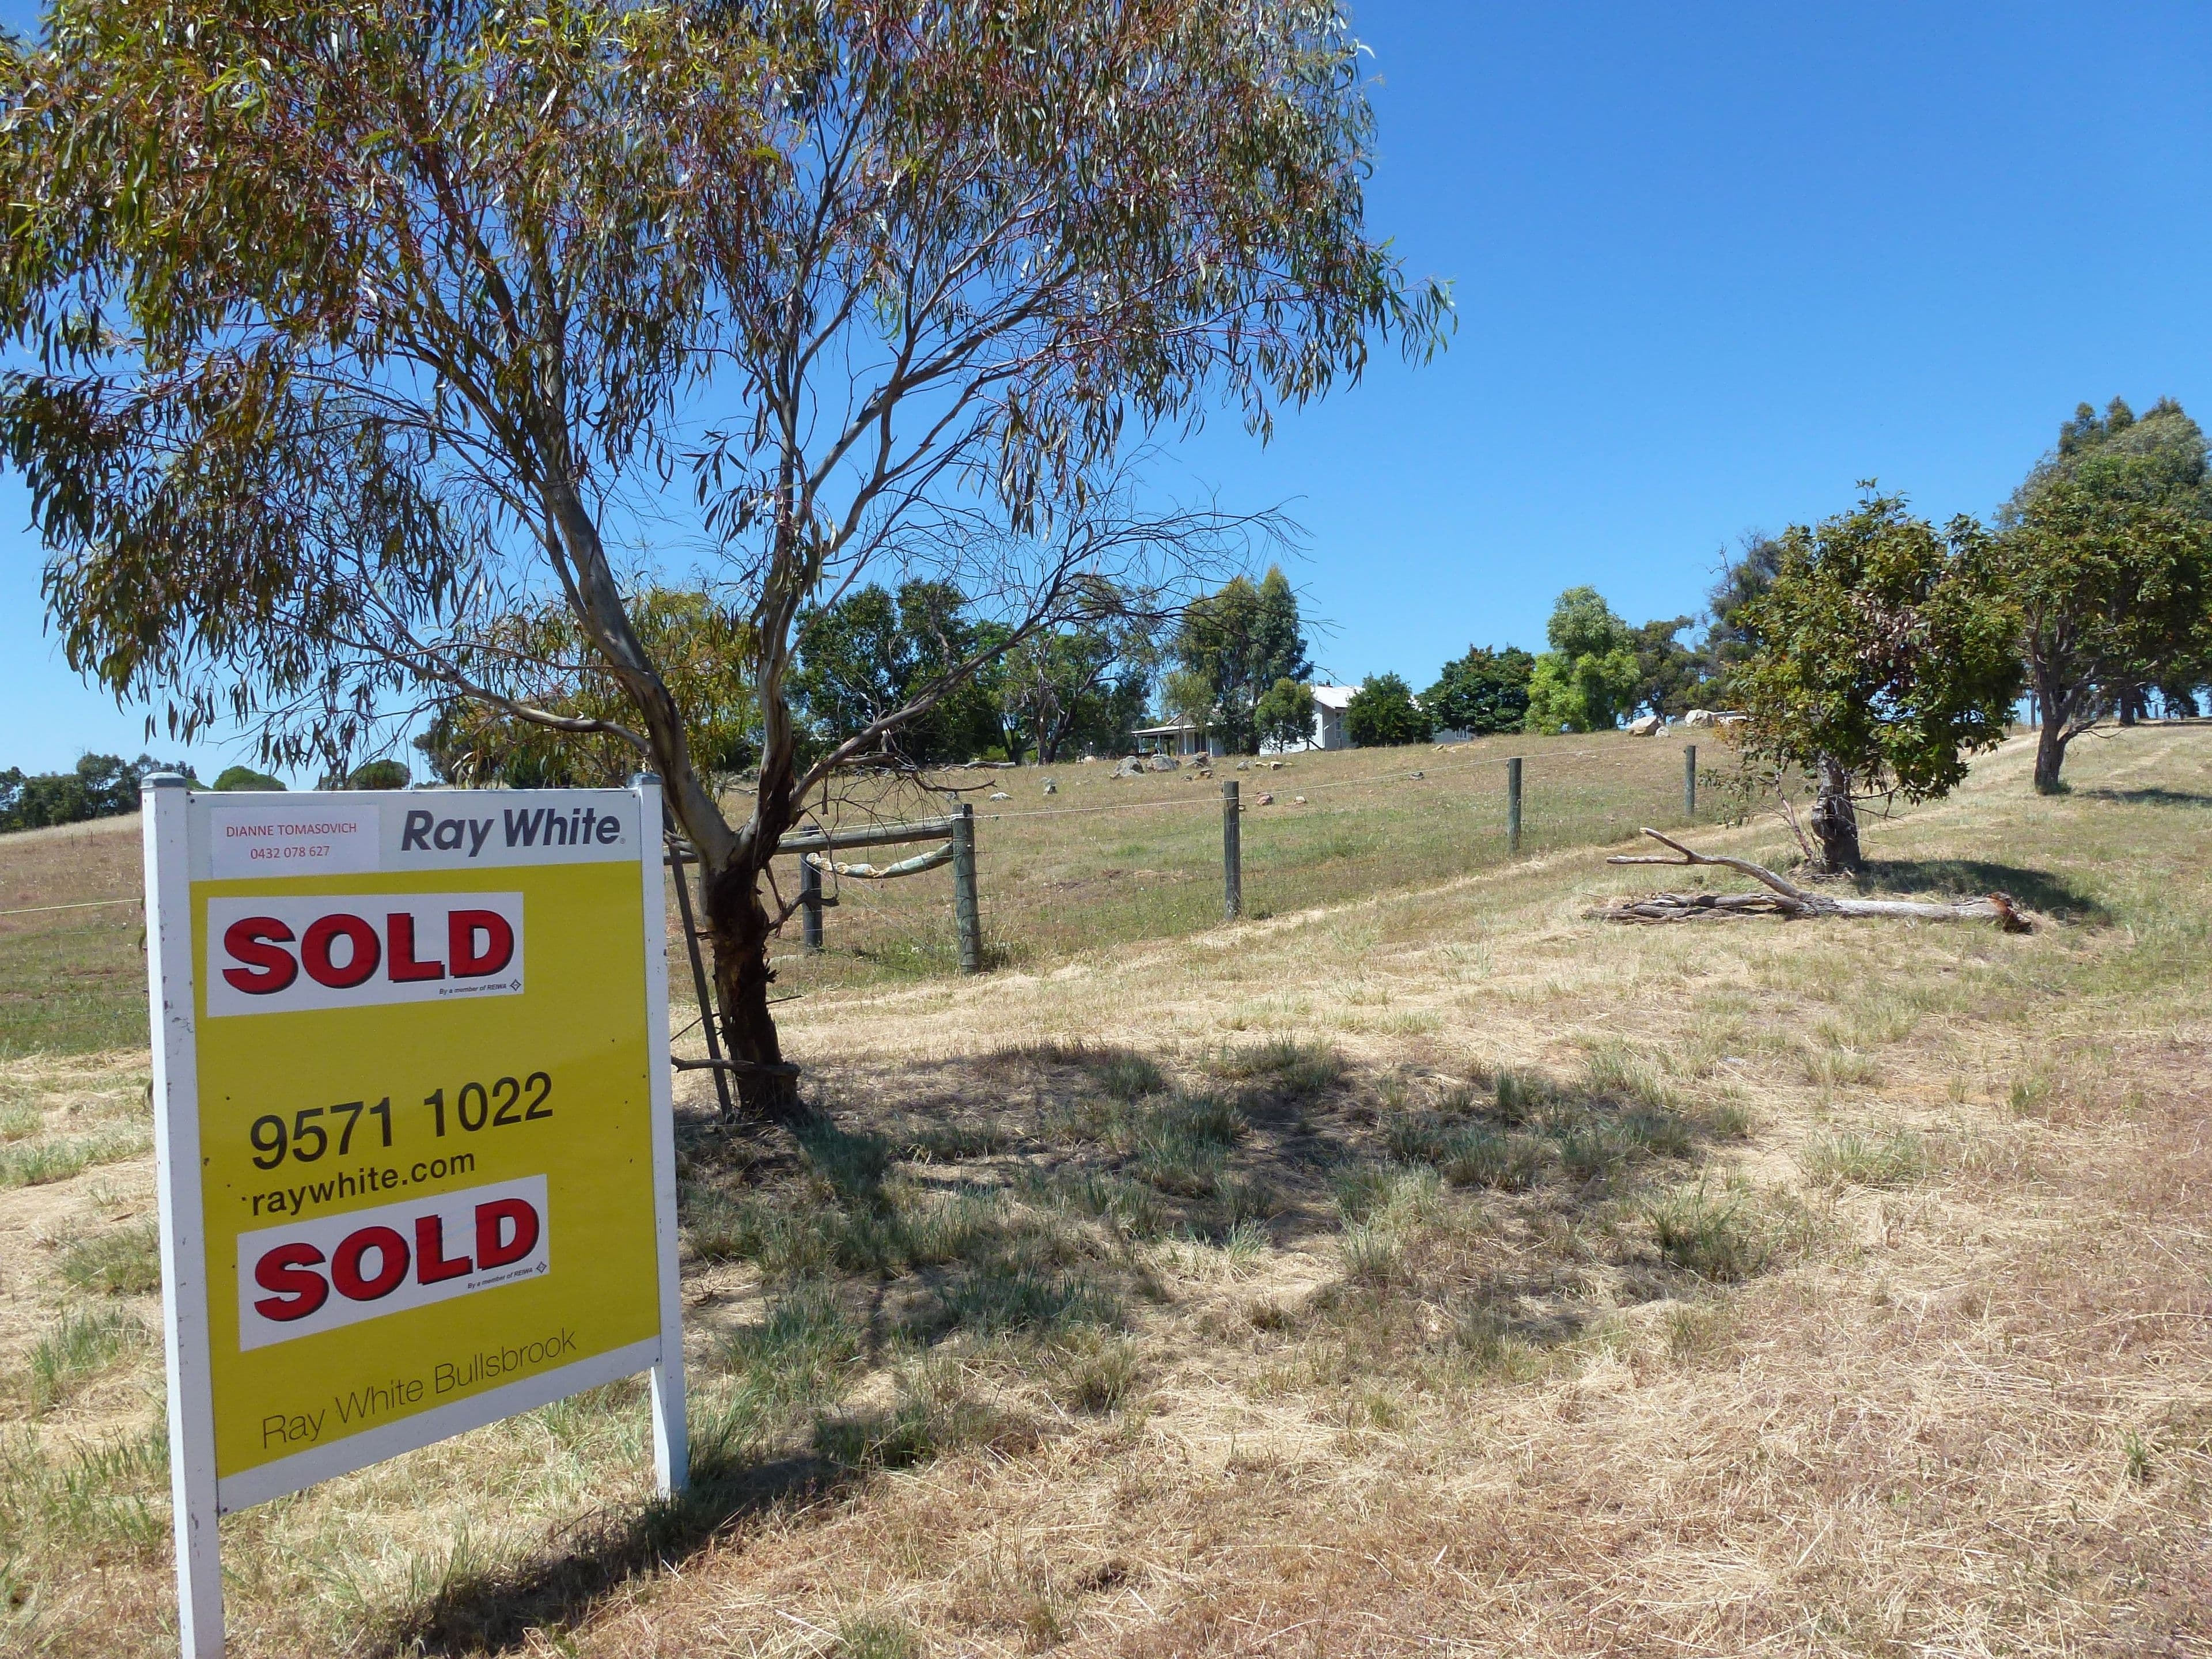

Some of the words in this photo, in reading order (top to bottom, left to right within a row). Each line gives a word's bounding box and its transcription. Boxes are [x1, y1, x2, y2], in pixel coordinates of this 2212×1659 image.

[226, 825, 274, 838] DIANNE
[277, 823, 357, 836] TOMASOVICH
[250, 847, 281, 859] 0432
[283, 846, 306, 858] 078
[309, 845, 331, 857] 627
[402, 809, 494, 857] Ray
[504, 807, 621, 848] White
[222, 909, 515, 995] SOLD
[454, 986, 478, 994] member
[250, 1096, 393, 1171] 9571
[423, 1071, 554, 1138] 1022
[252, 1153, 475, 1216] raywhite.com
[254, 1198, 540, 1322] SOLD
[482, 1275, 506, 1285] member
[513, 1267, 533, 1277] REIWA
[263, 1409, 326, 1449] Ray
[335, 1380, 424, 1423] White
[434, 1327, 577, 1394] Bullsbrook
